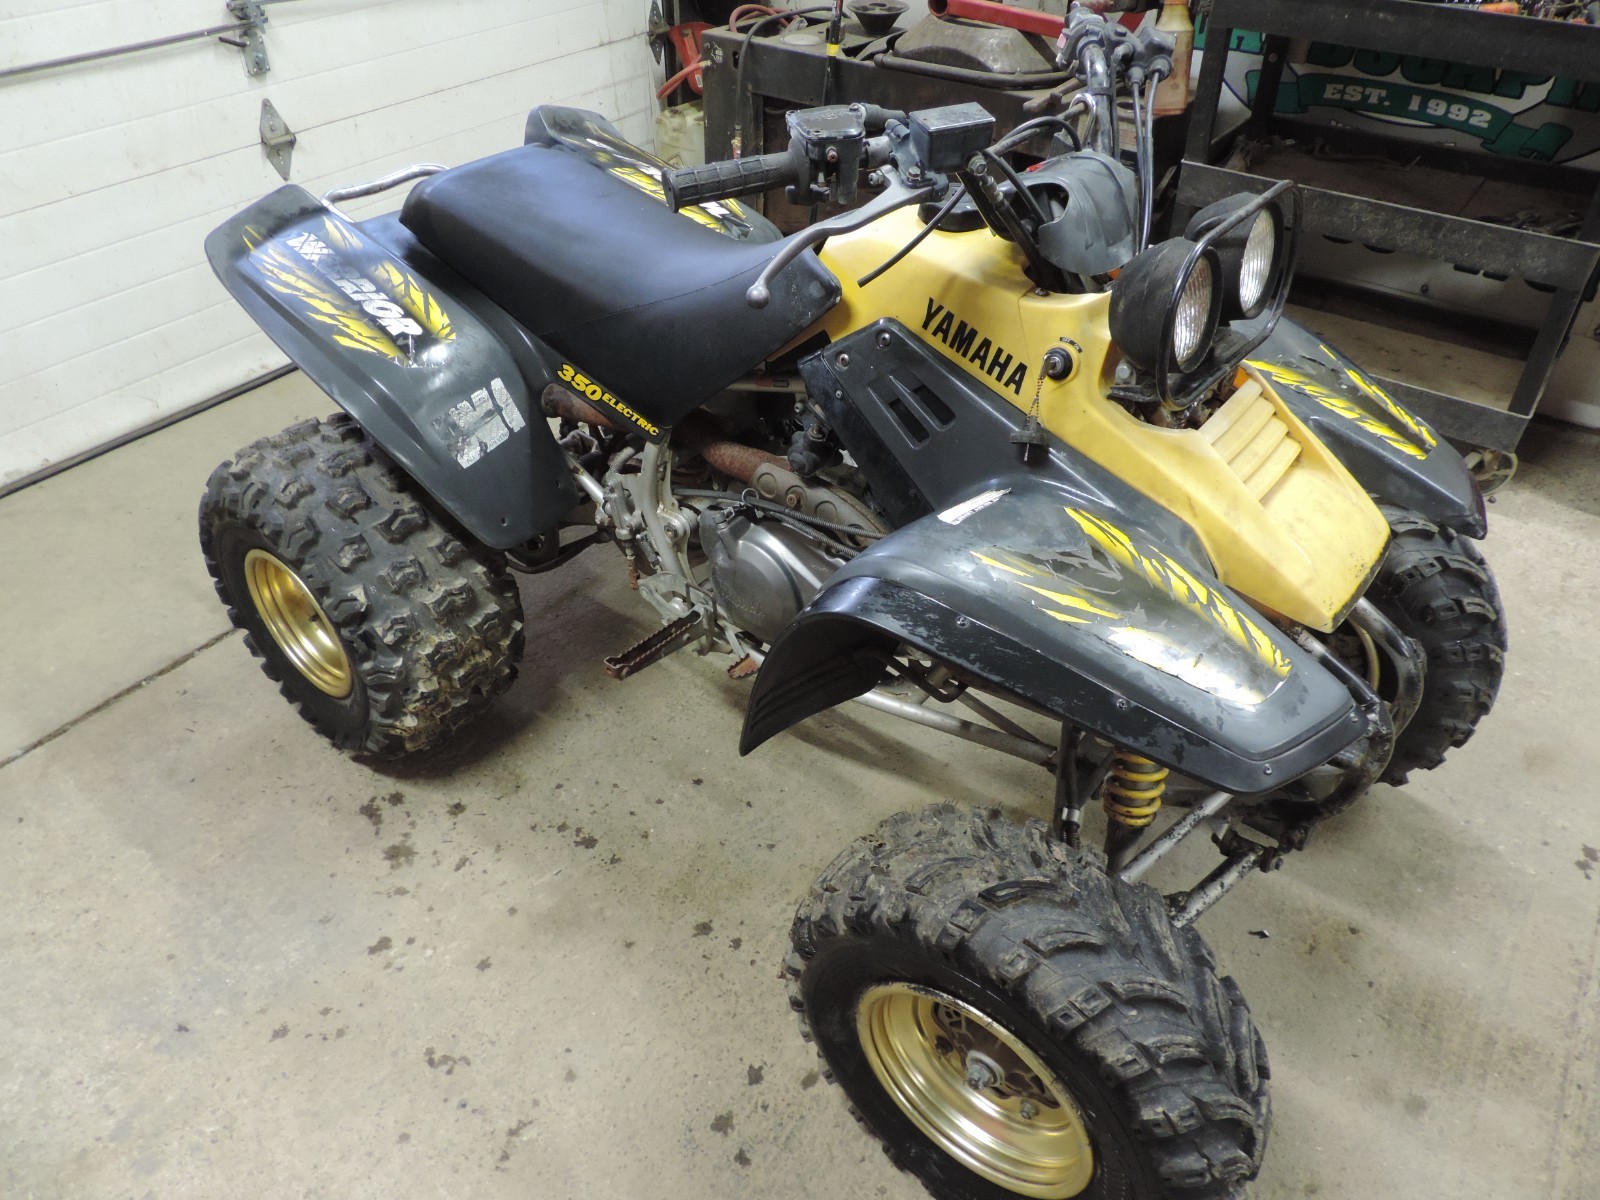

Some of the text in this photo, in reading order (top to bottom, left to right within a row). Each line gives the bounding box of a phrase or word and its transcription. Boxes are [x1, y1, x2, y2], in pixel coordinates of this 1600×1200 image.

[1323, 83, 1492, 129] EST. 1992
[921, 296, 1028, 396] YAMAHA
[557, 364, 660, 436] 350 ELECTRIC
